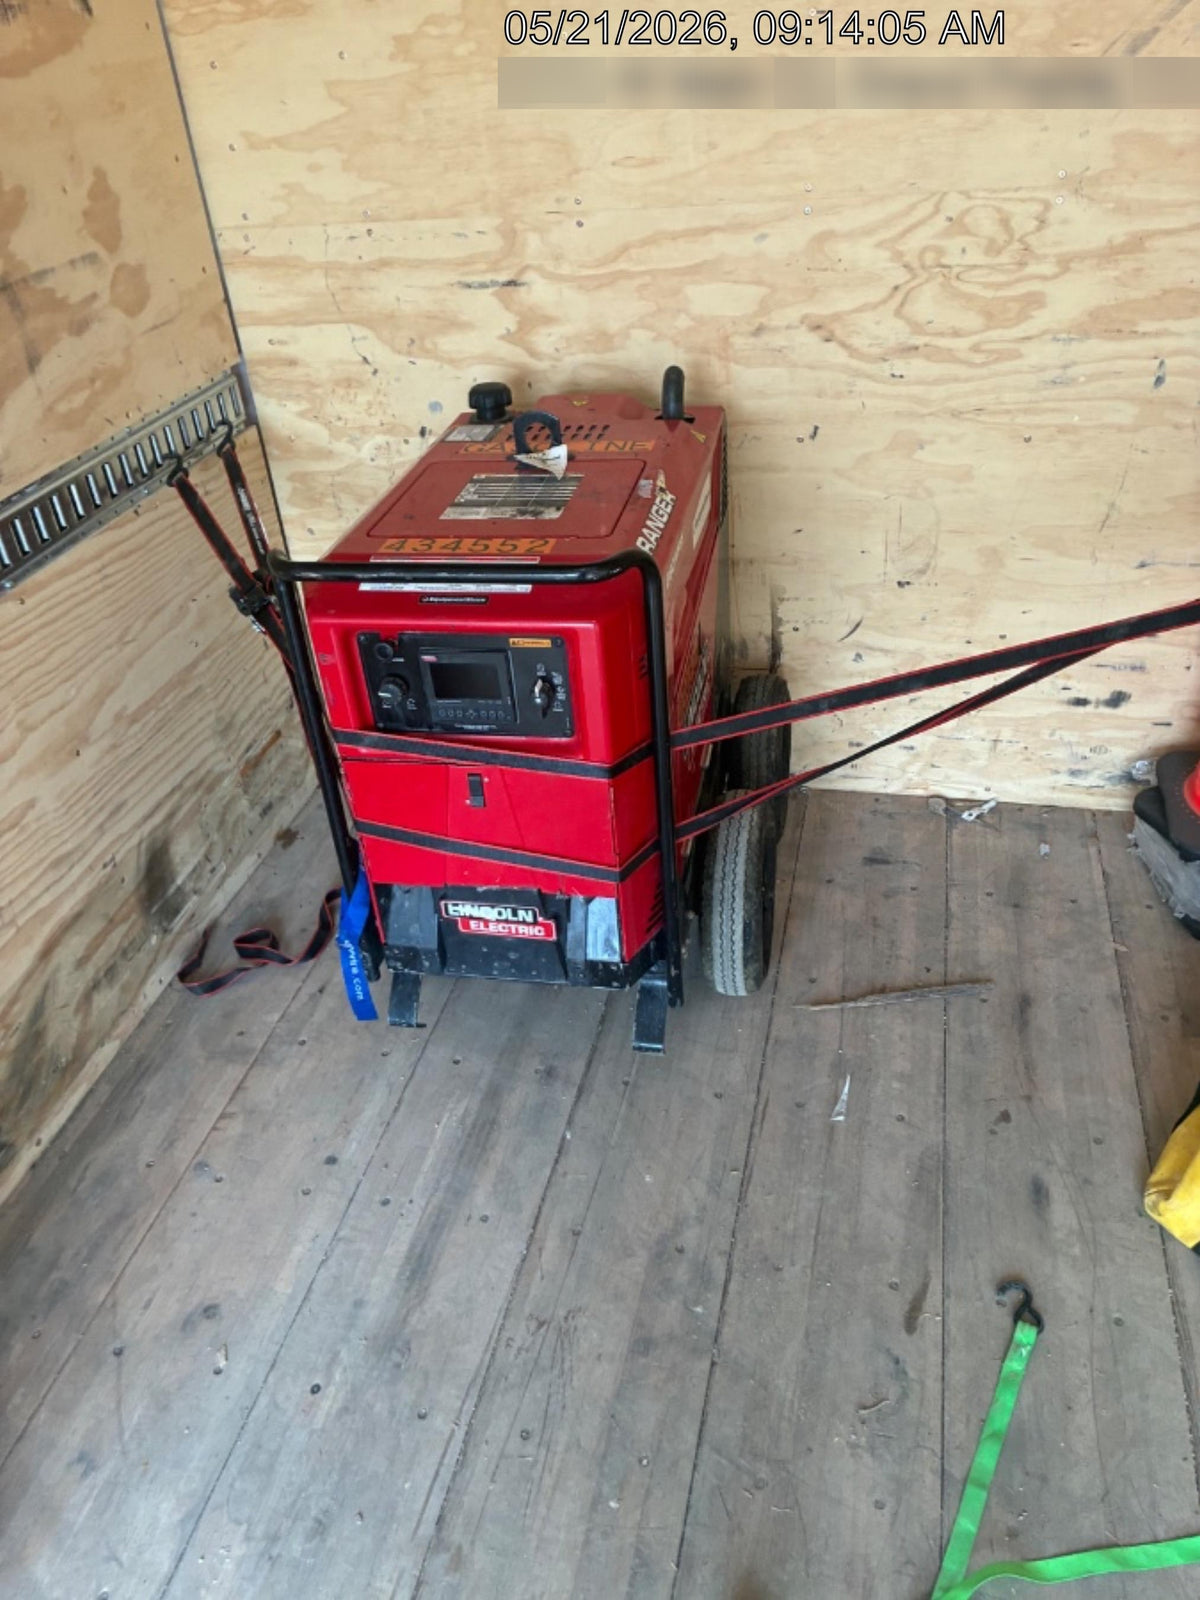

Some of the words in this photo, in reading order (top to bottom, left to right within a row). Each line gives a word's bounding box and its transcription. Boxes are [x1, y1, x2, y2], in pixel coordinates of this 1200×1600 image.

[465, 440, 649, 453] GAINE
[384, 539, 549, 552] 434552
[469, 920, 545, 936] ELECTRIC
